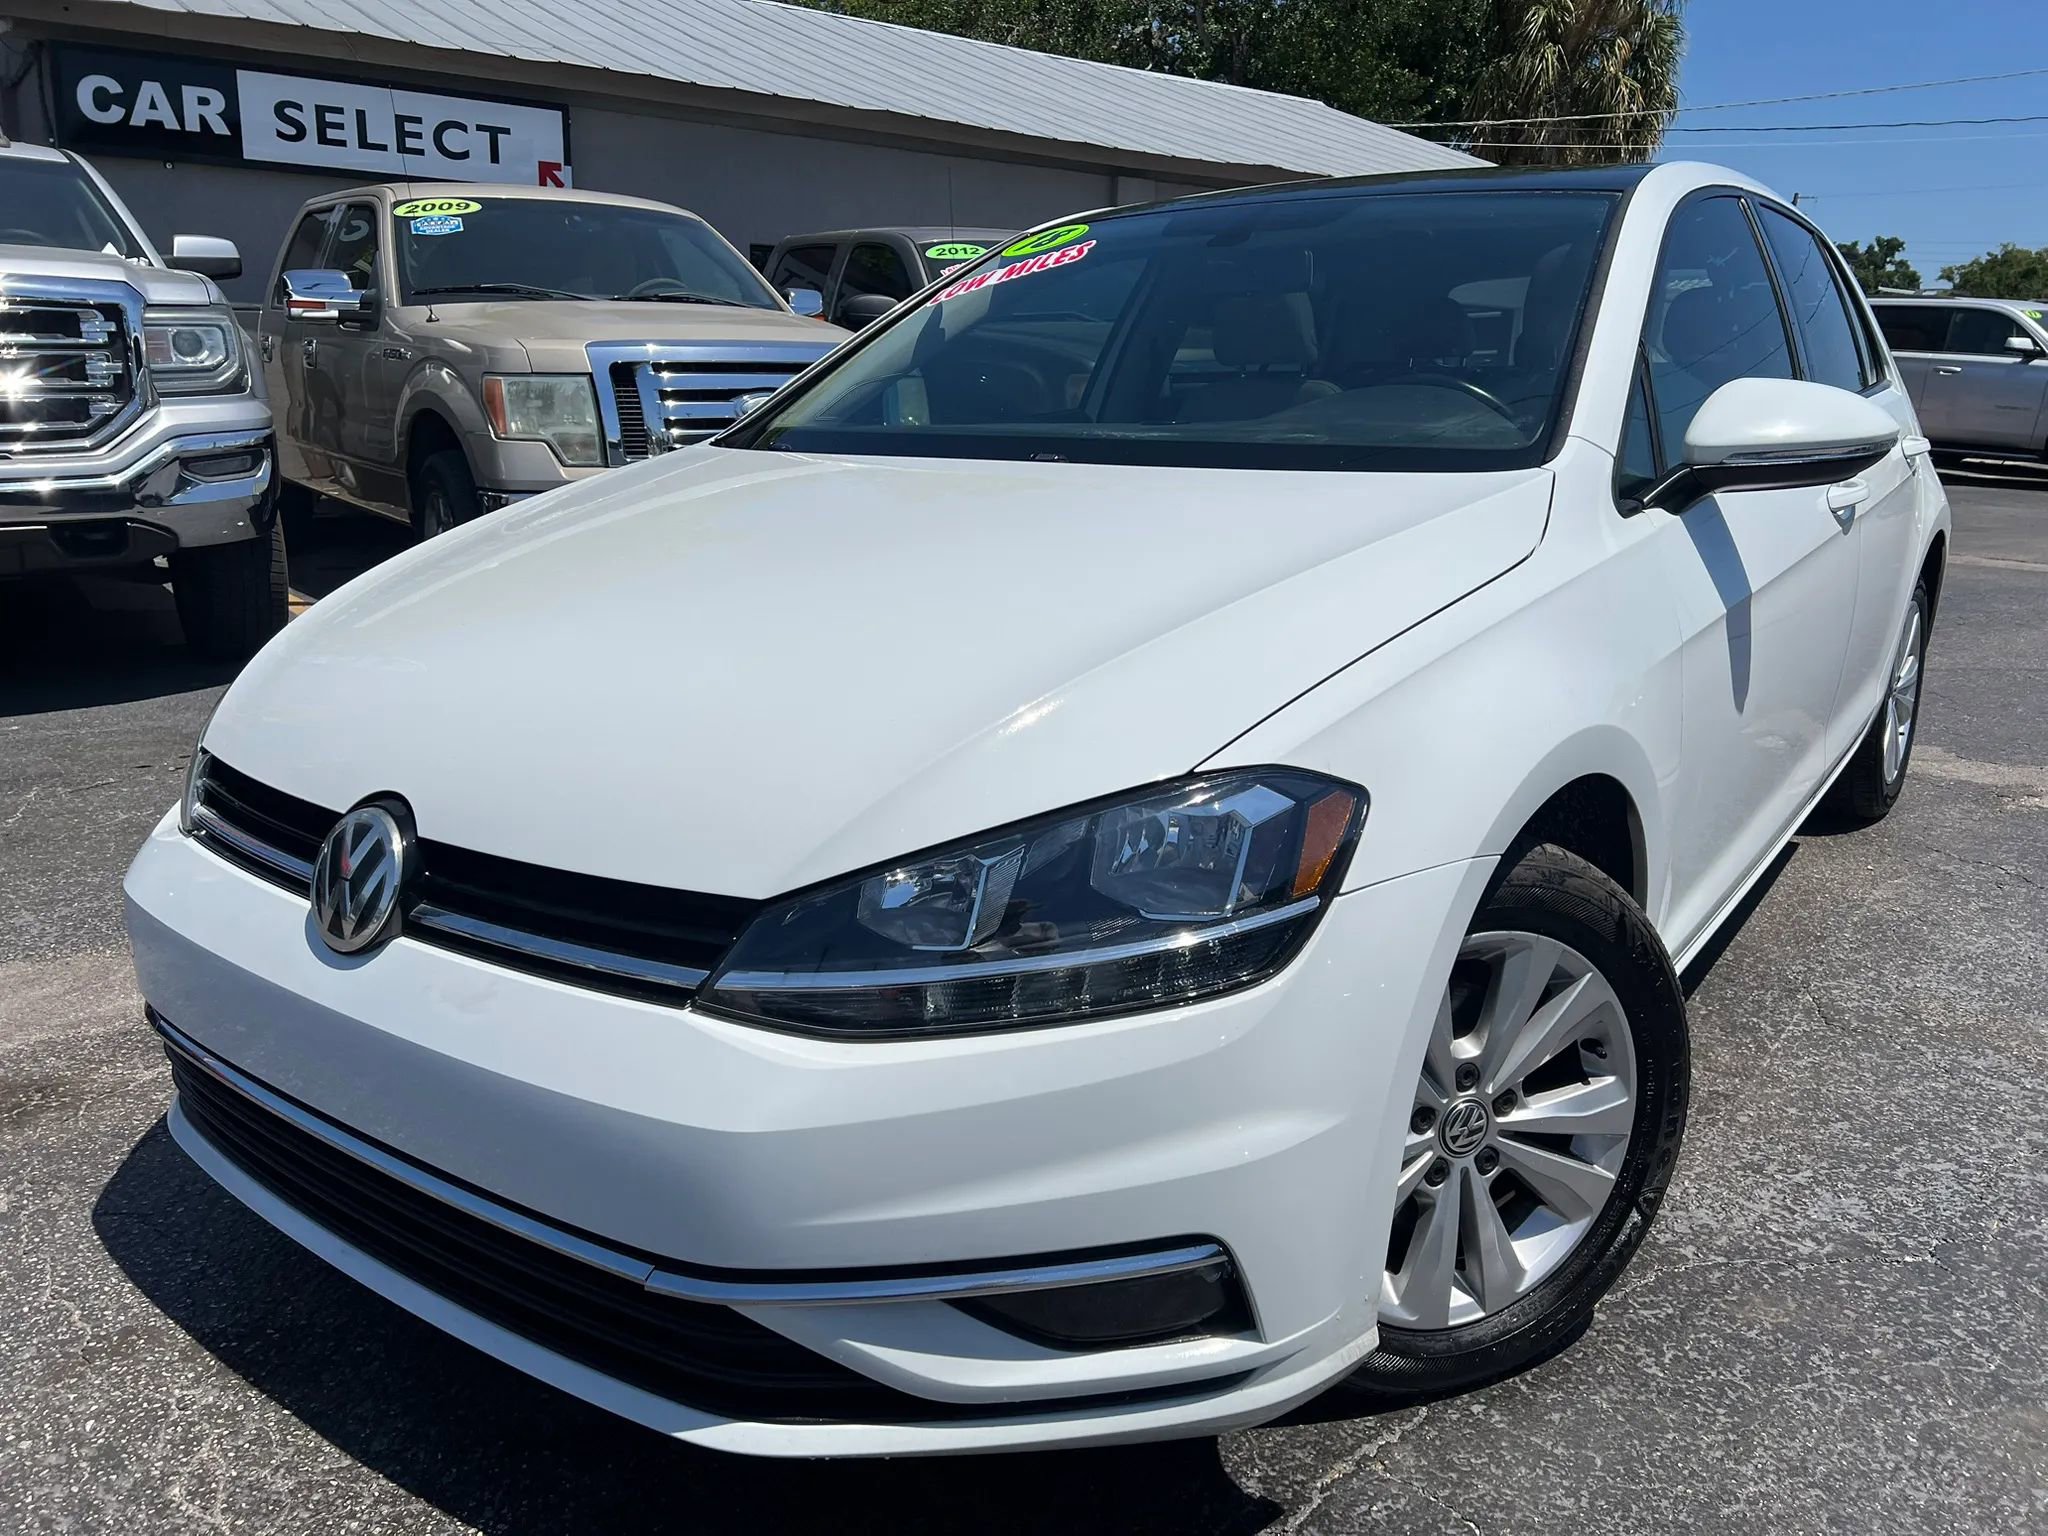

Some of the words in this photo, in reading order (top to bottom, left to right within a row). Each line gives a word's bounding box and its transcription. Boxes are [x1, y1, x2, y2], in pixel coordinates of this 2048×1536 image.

[76, 74, 231, 136] CAR
[273, 100, 511, 165] SELECT
[403, 202, 471, 214] 2009
[936, 247, 981, 257] 2012
[930, 271, 995, 305] LOW
[996, 242, 1095, 282] MILES
